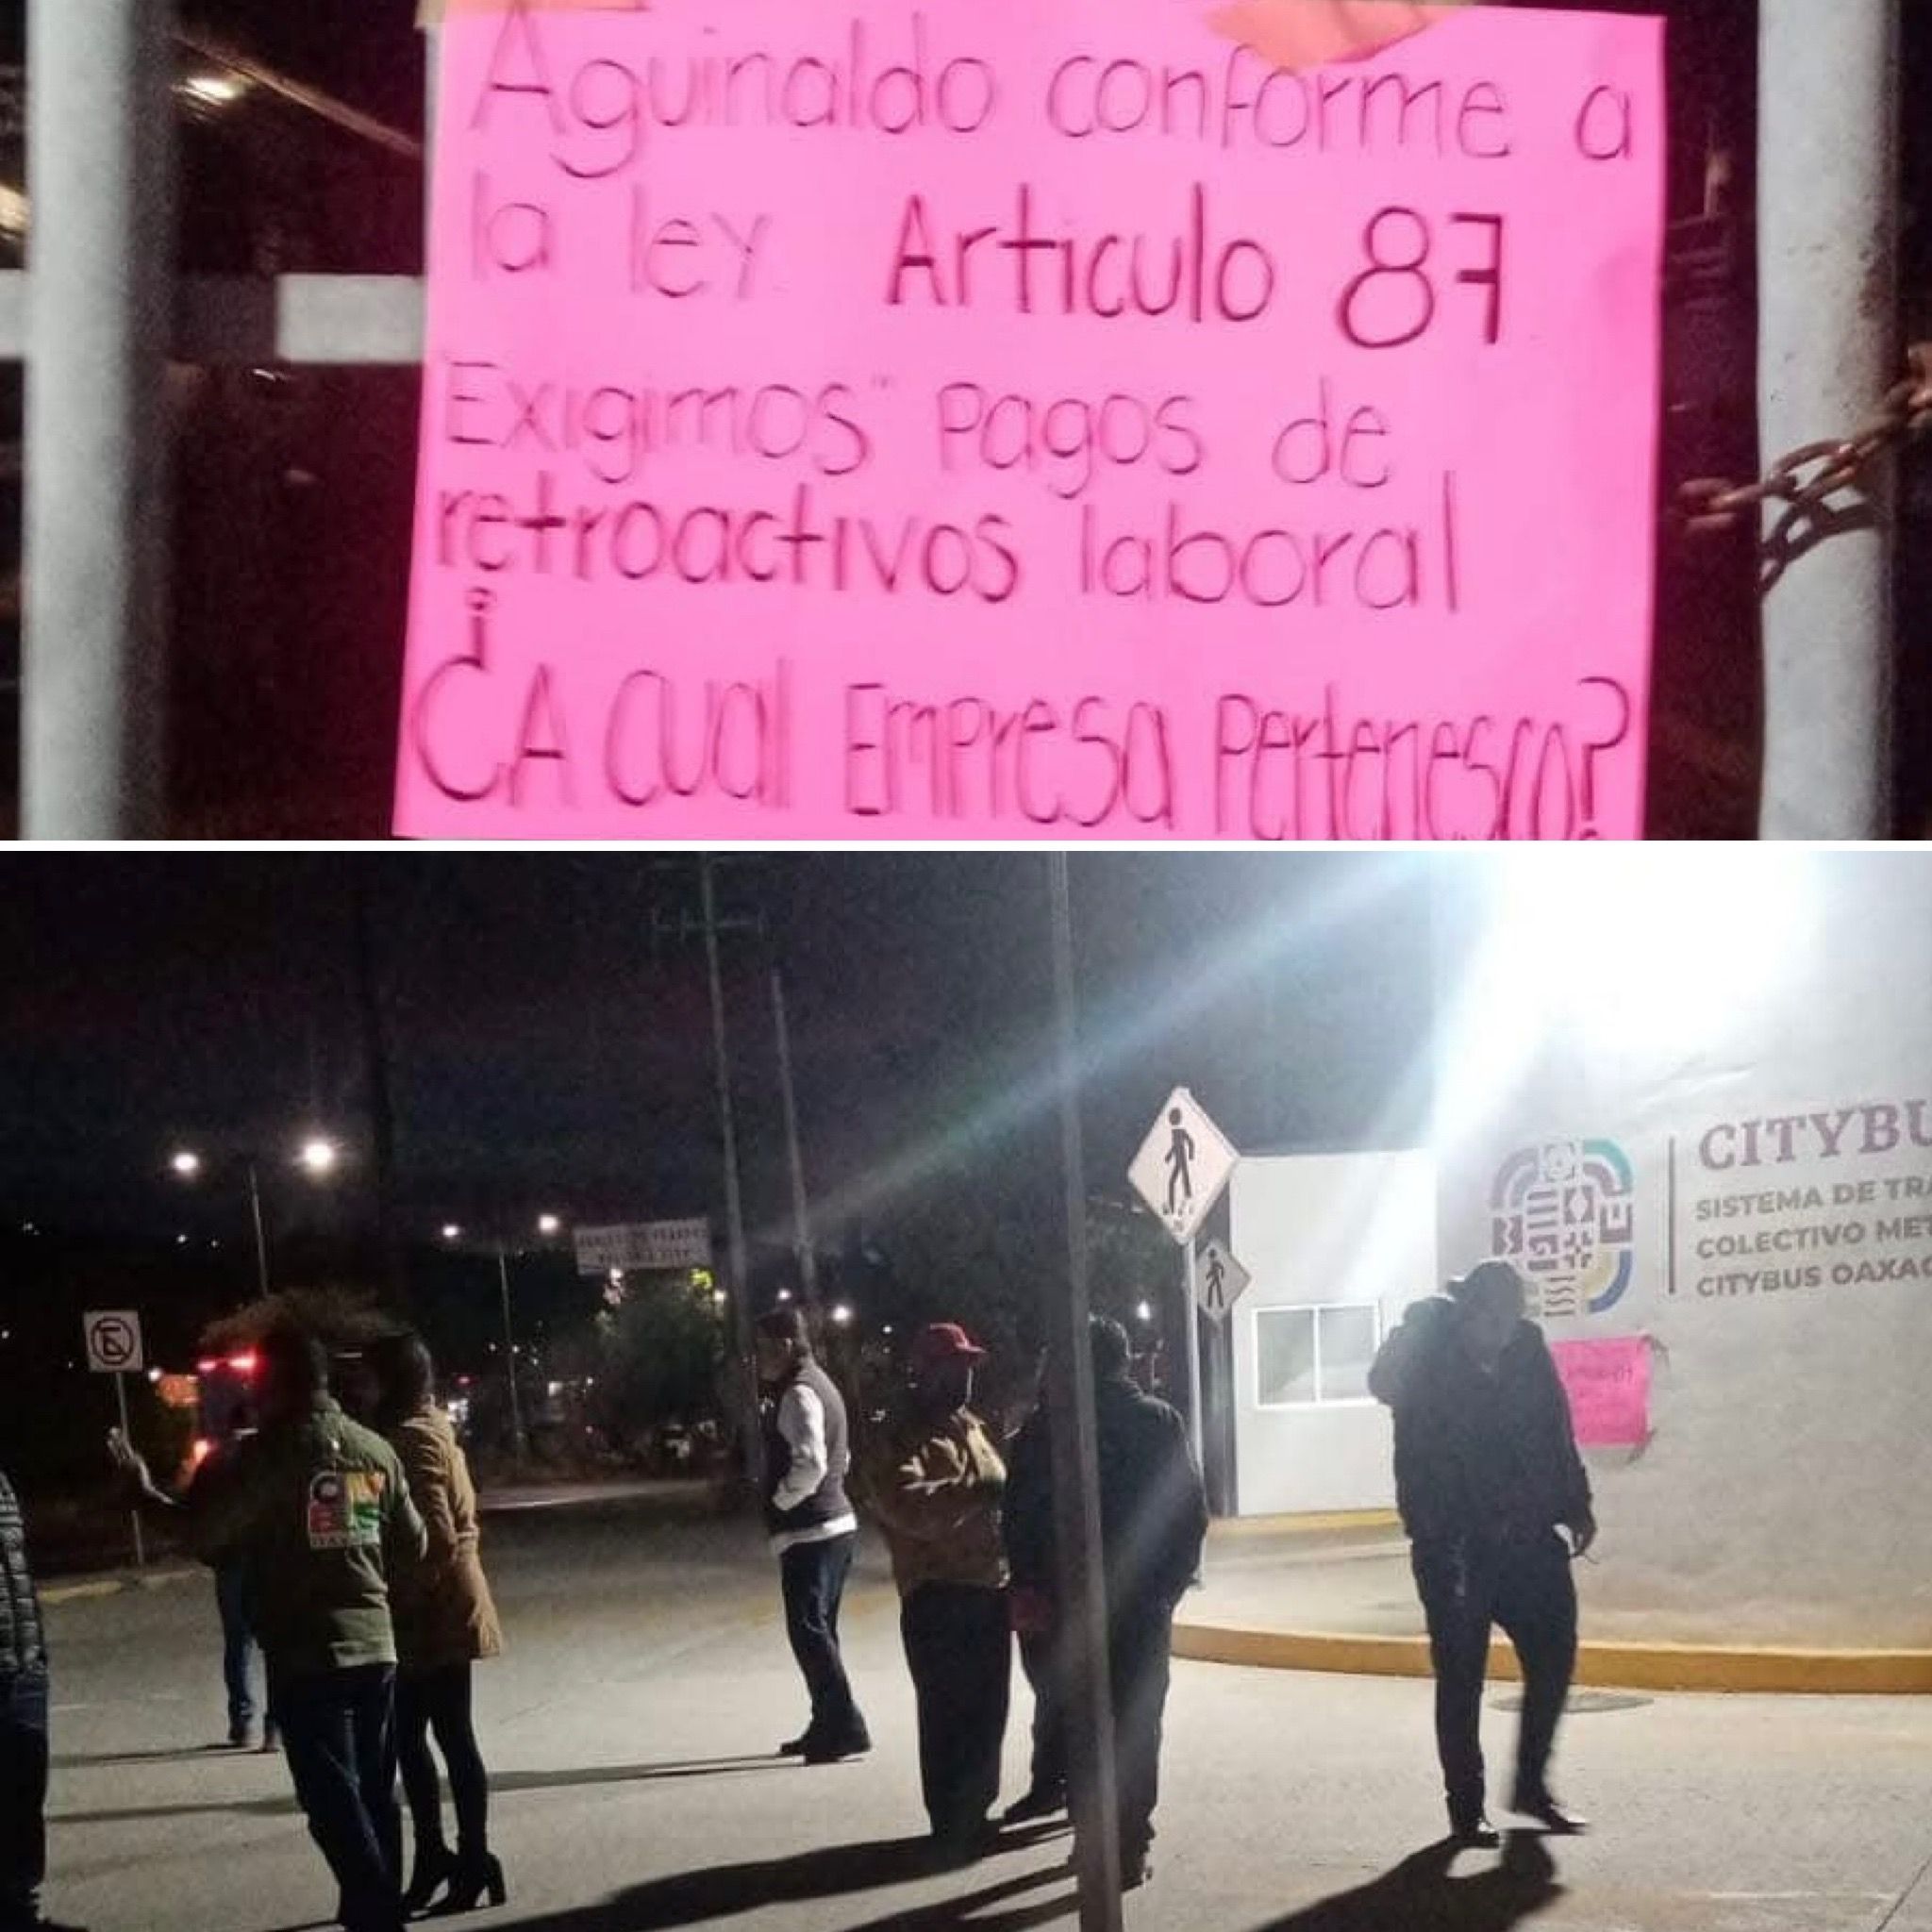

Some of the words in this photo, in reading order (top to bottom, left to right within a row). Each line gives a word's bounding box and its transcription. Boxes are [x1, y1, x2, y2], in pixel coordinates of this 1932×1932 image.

[470, 2, 994, 179] Aguinaldo
[1046, 43, 1511, 158] conforme
[1575, 84, 1633, 161] a
[472, 172, 553, 278] la
[1336, 206, 1504, 349] 87
[1272, 377, 1391, 489] de
[438, 472, 1020, 604] retroactivos
[1080, 471, 1459, 613] laboral
[1696, 1186, 1823, 1222] SISTEMA
[1832, 1180, 1877, 1207] DE
[1697, 1221, 1866, 1259] COLECTIVO
[1697, 1266, 1822, 1297] CITYBUS
